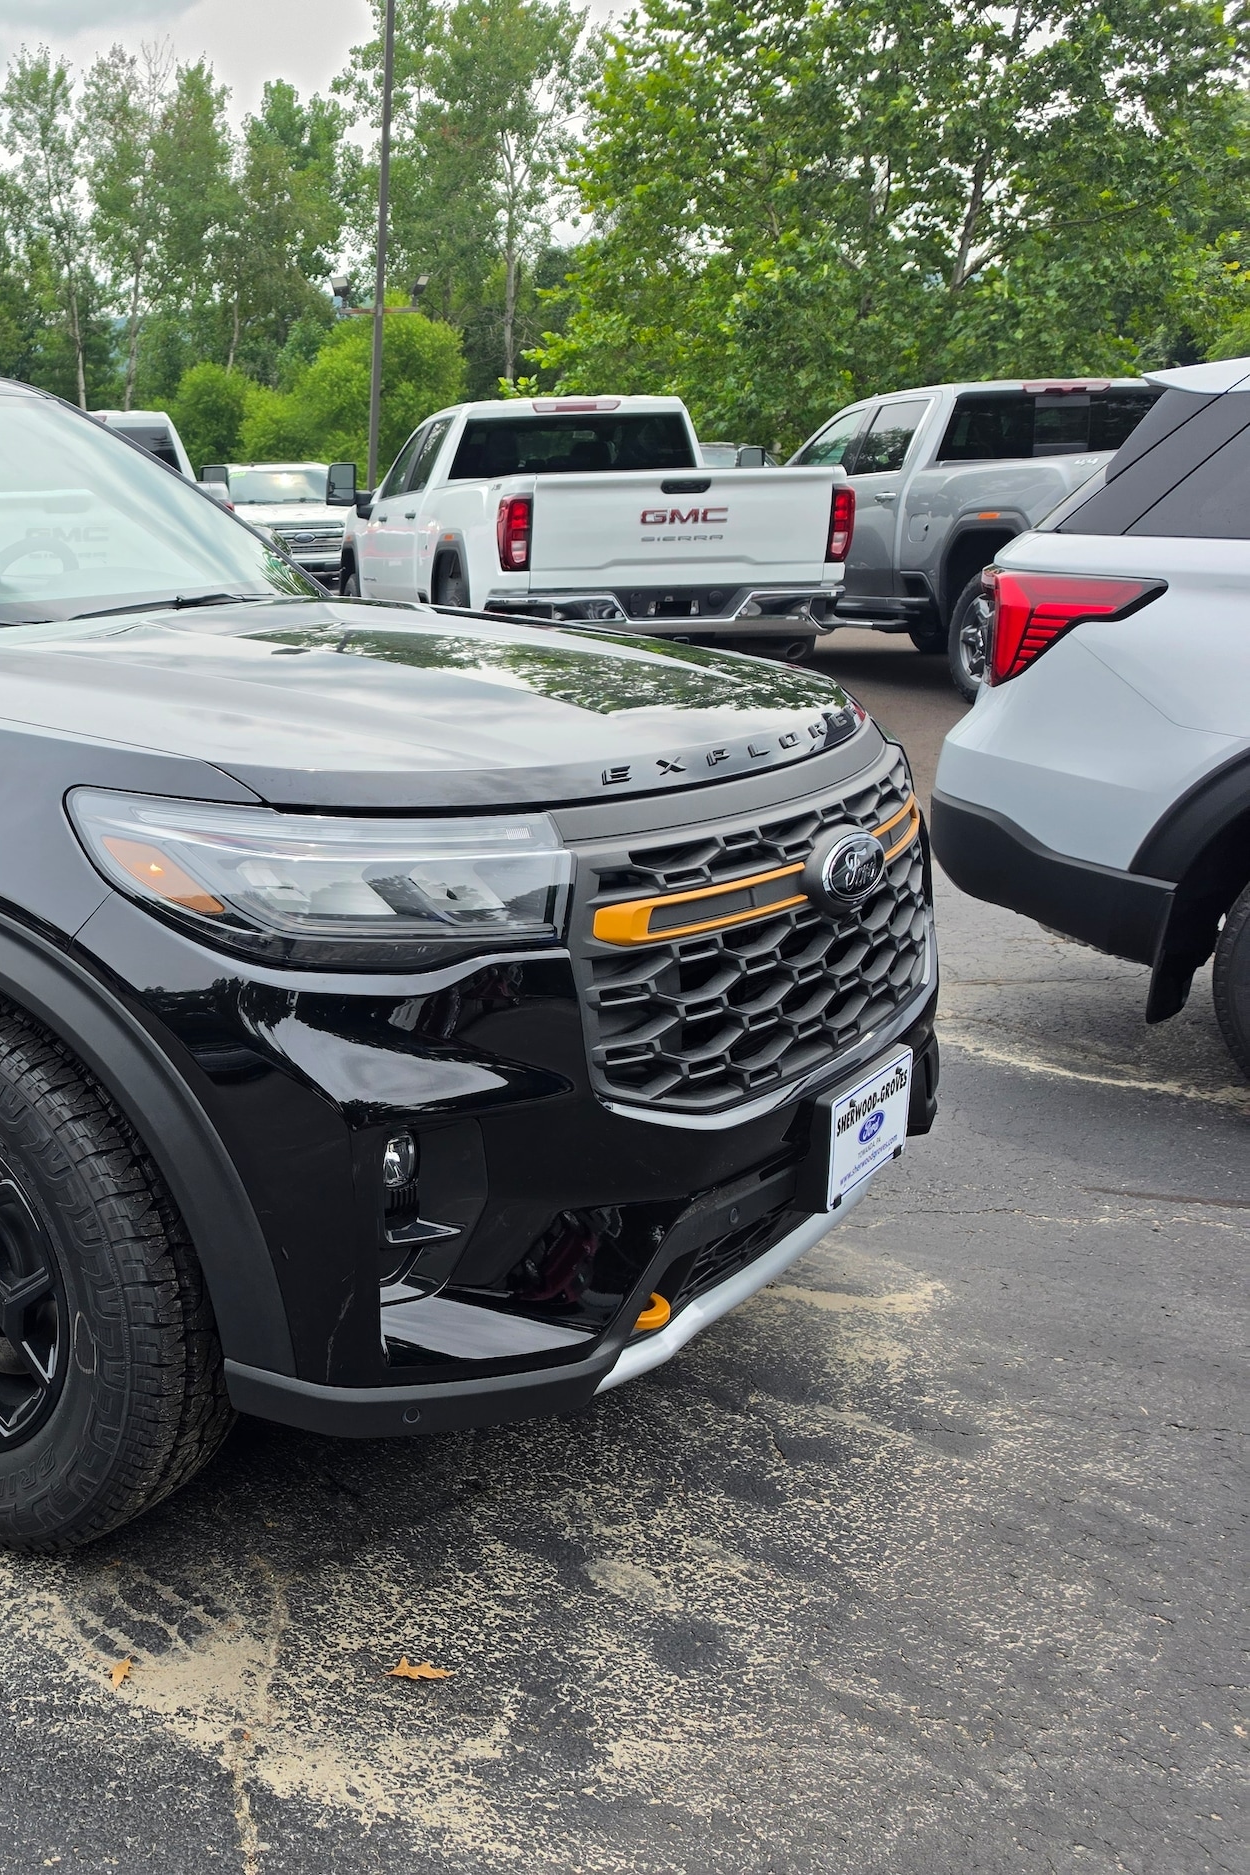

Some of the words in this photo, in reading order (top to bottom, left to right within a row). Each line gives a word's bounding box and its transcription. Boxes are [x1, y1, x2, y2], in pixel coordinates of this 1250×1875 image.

[640, 507, 729, 525] GMC
[641, 534, 724, 542] SIERRA
[836, 1069, 909, 1137] SHERWOOD-GROVES
